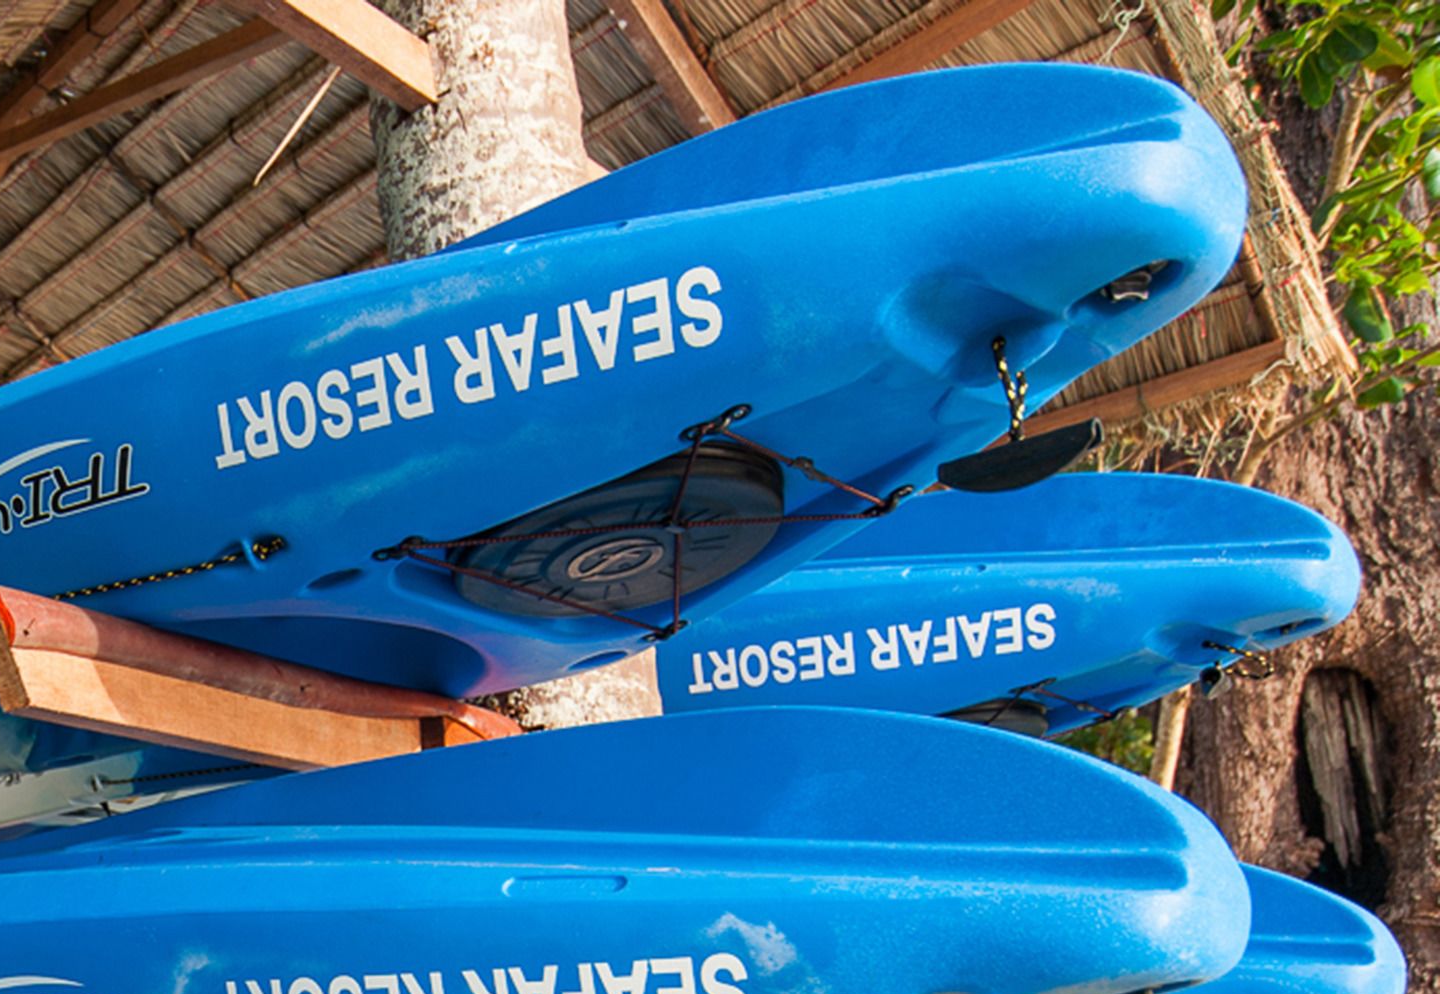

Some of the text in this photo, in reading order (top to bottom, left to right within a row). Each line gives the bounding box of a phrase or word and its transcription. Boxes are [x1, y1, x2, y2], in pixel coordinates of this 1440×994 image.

[216, 266, 723, 469] SEAFAR RESORT
[688, 603, 1056, 694] SEAFAR RESORT
